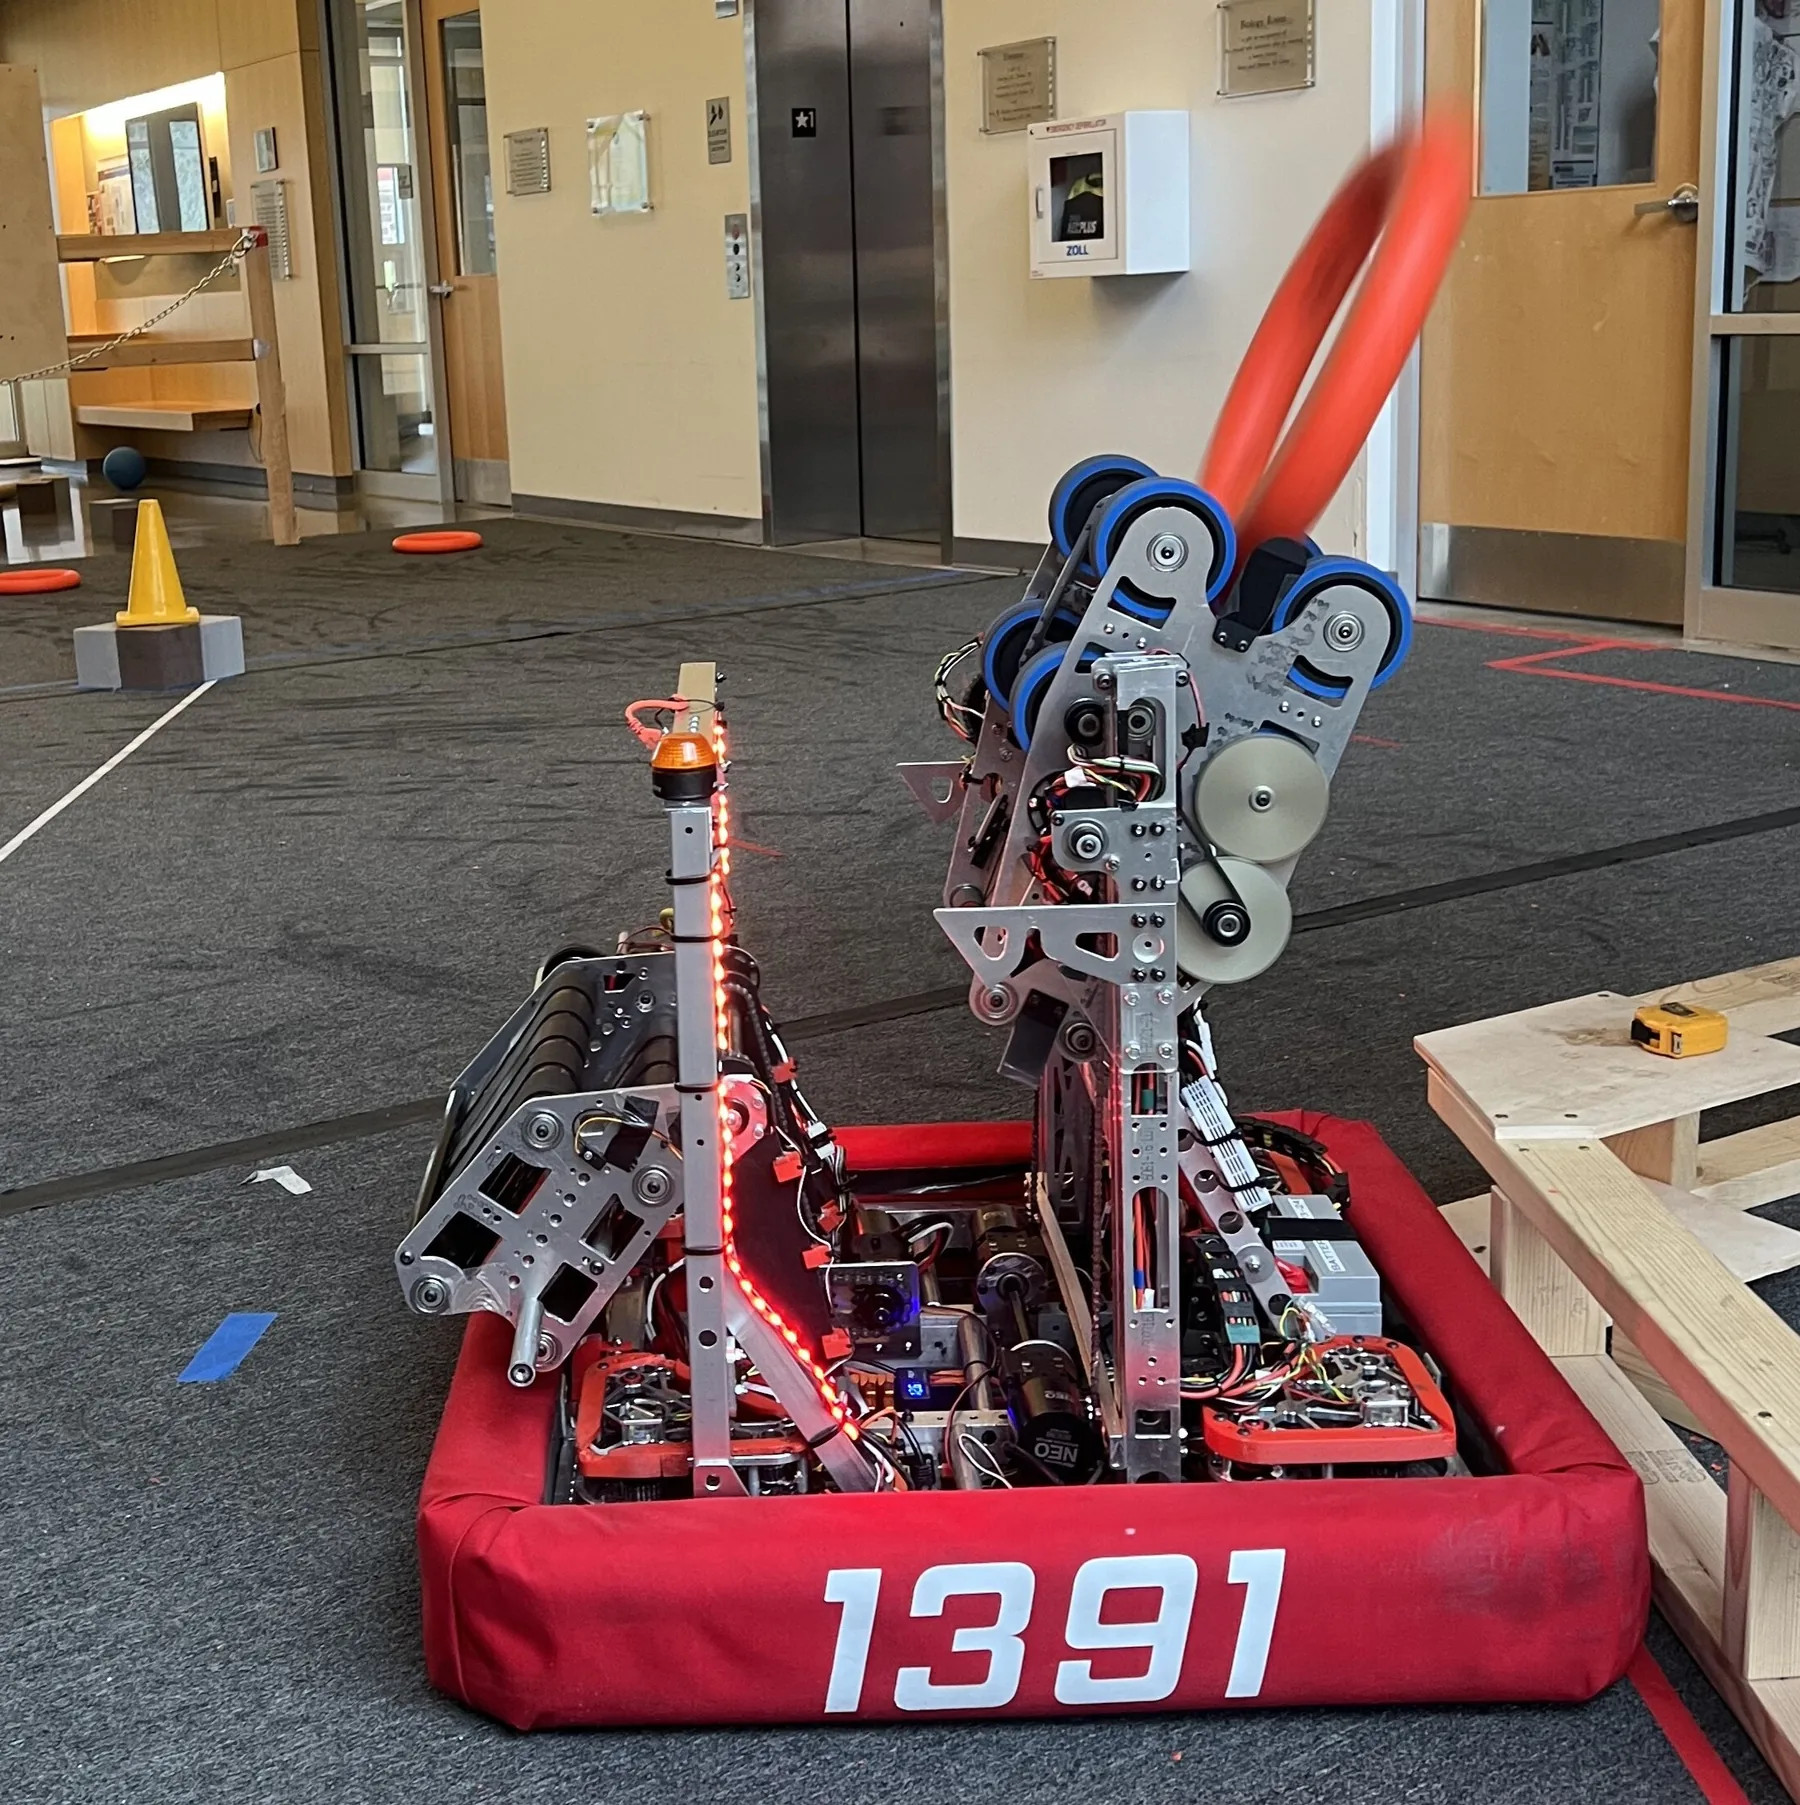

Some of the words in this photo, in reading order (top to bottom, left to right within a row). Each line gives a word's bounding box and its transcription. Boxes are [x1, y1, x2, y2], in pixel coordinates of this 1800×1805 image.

[1066, 245, 1089, 256] ZOLL
[1034, 1442, 1079, 1463] NEO
[824, 1548, 1286, 1713] 1391
